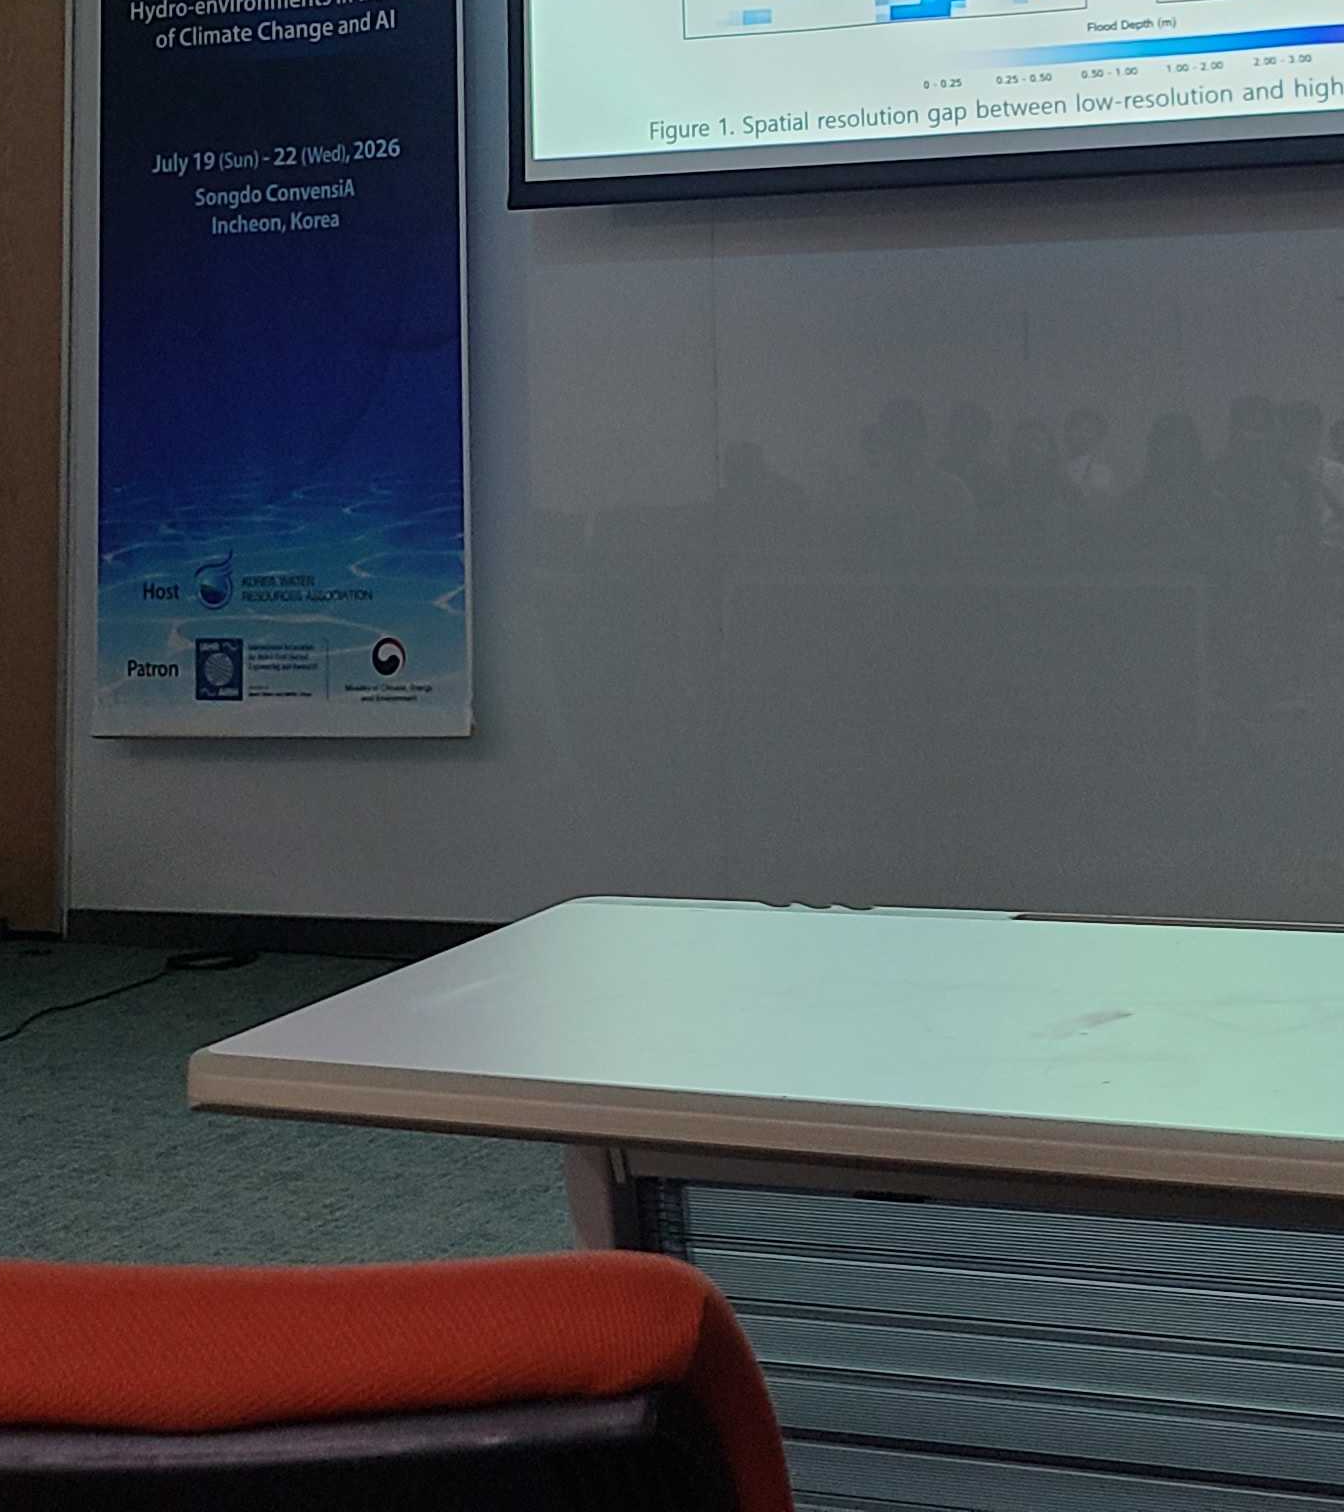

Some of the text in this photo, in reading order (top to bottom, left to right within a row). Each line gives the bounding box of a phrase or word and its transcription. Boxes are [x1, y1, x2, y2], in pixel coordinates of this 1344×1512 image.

[155, 9, 395, 49] of Climate Change and AI
[1086, 16, 1177, 32] Flood Depth (m)
[649, 119, 710, 145] Figure
[718, 117, 735, 137] 1.
[742, 111, 809, 140] Spatial
[817, 106, 919, 130] resolution
[927, 105, 967, 129] gap
[976, 98, 1067, 119] between
[1075, 85, 1233, 113] low-resolution
[1242, 78, 1284, 102] and
[151, 138, 401, 177] July 19 (Sun) 22 (Wed), 2026
[195, 178, 355, 210] Songdo ConvensiA
[211, 211, 340, 235] Incheon, Korea
[142, 581, 180, 601] Host
[127, 660, 180, 679] Patron
